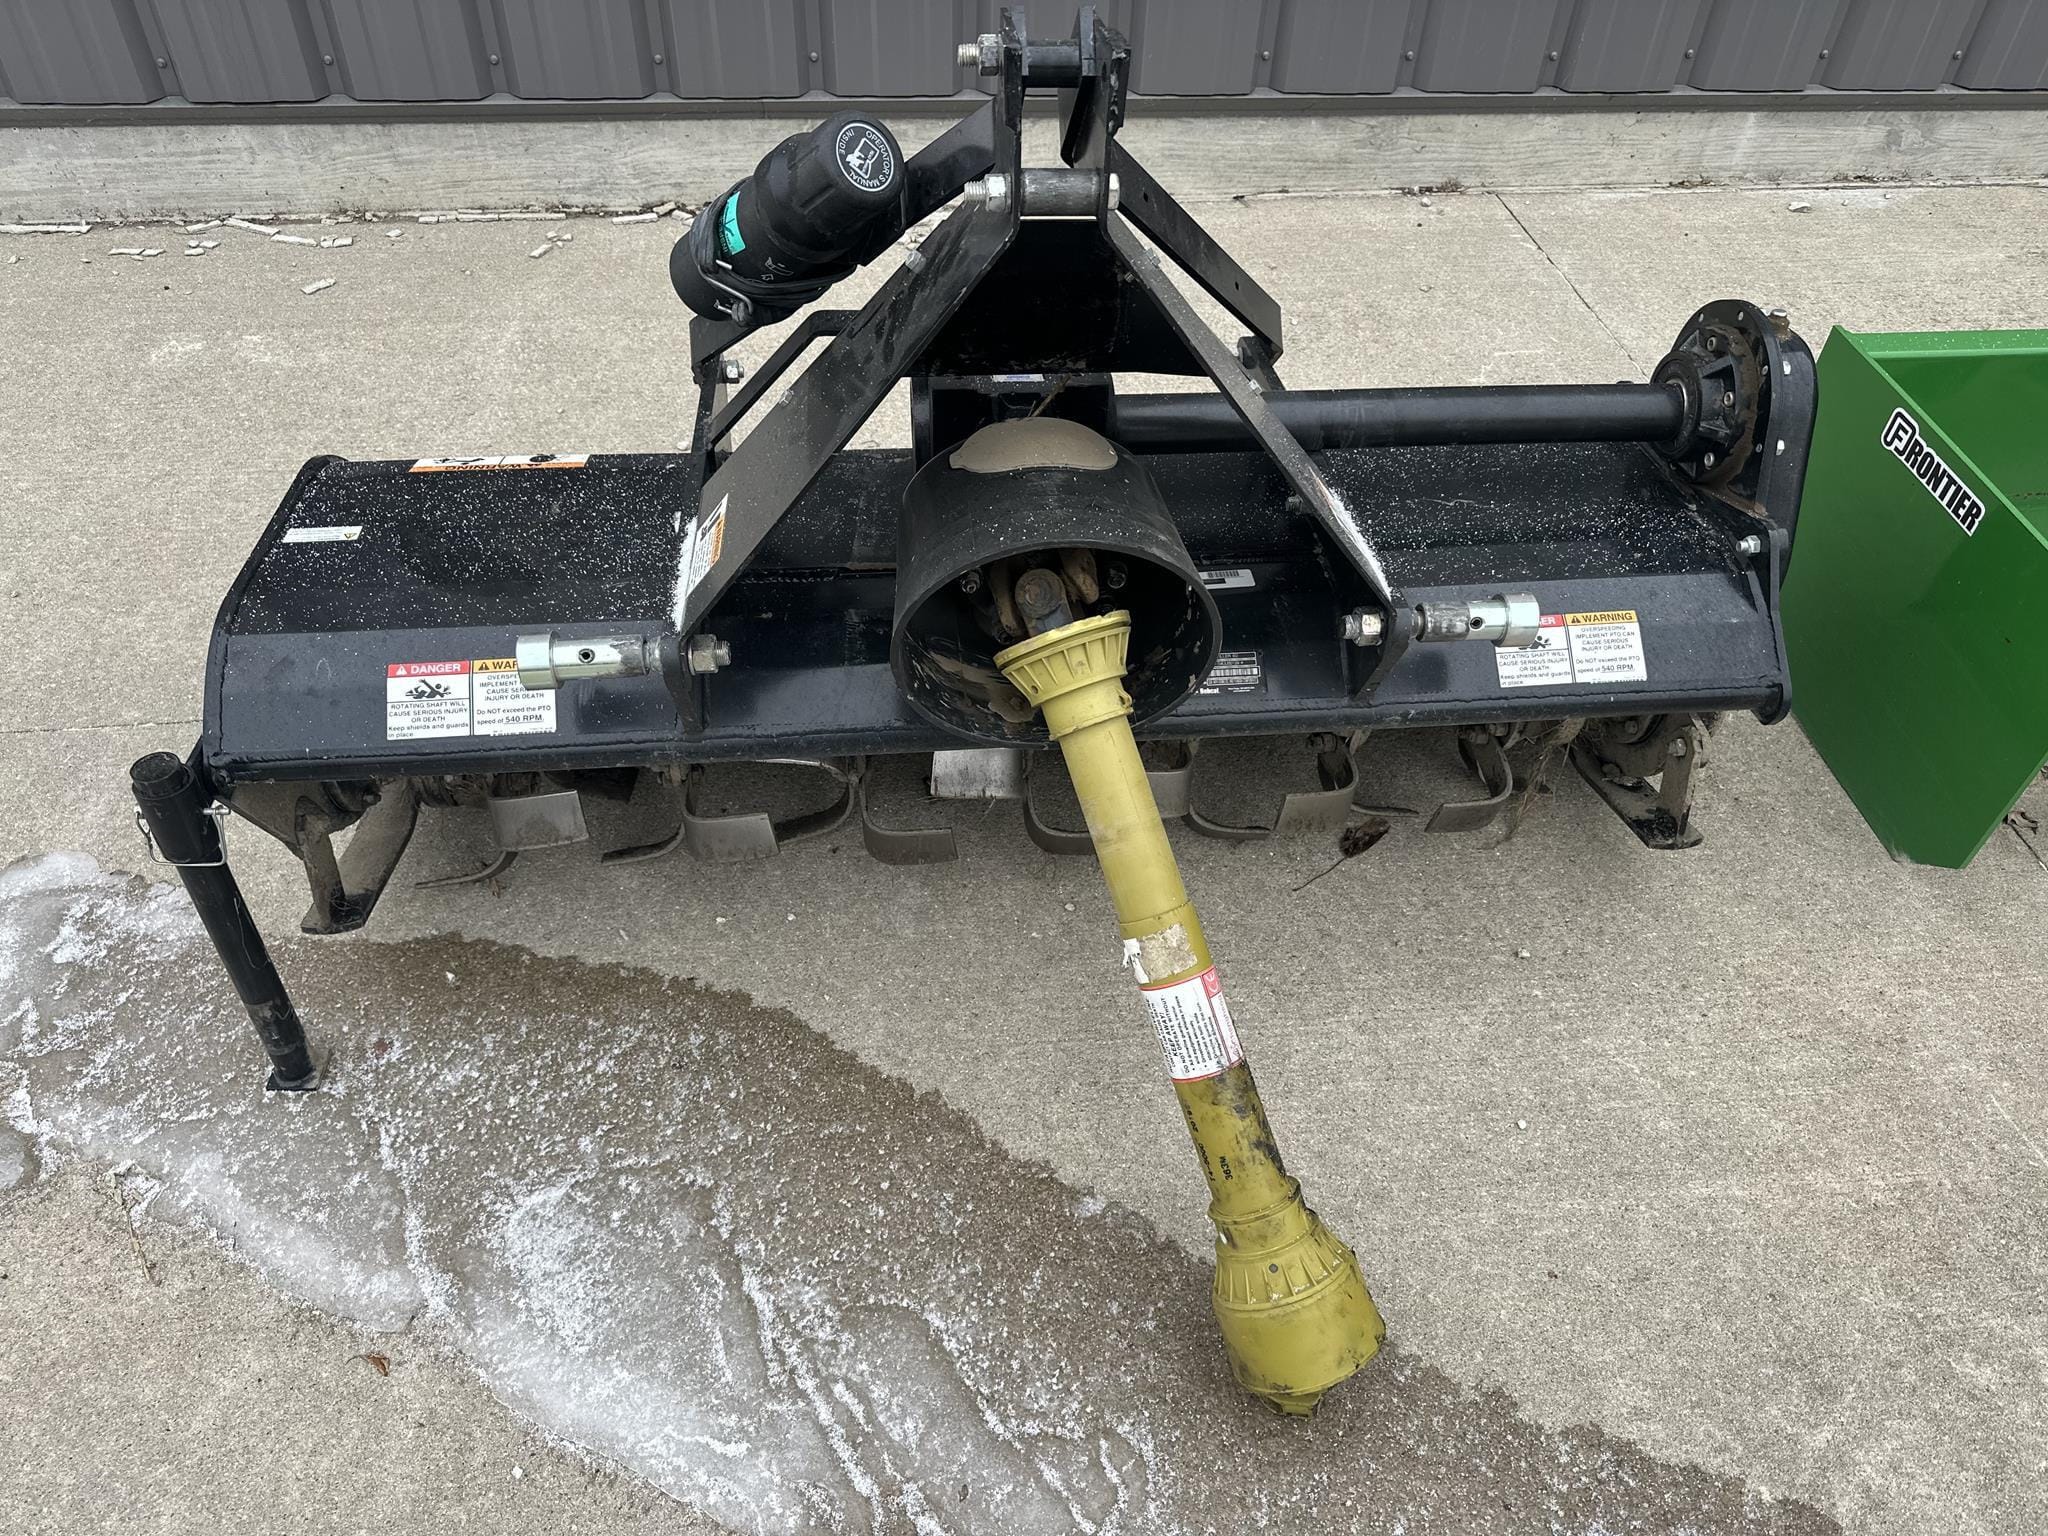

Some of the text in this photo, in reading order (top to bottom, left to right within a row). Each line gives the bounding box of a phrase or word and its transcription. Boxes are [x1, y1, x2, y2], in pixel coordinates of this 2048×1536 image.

[840, 129, 854, 155] INSIDE
[849, 131, 890, 187] OPERATOR'S MANUAL
[1582, 613, 1632, 622] WARNING
[411, 664, 460, 673] DANGER
[1167, 1037, 1177, 1056] KEEP
[1170, 1024, 1181, 1050] OPERATE
[1183, 1064, 1189, 1073] DO
